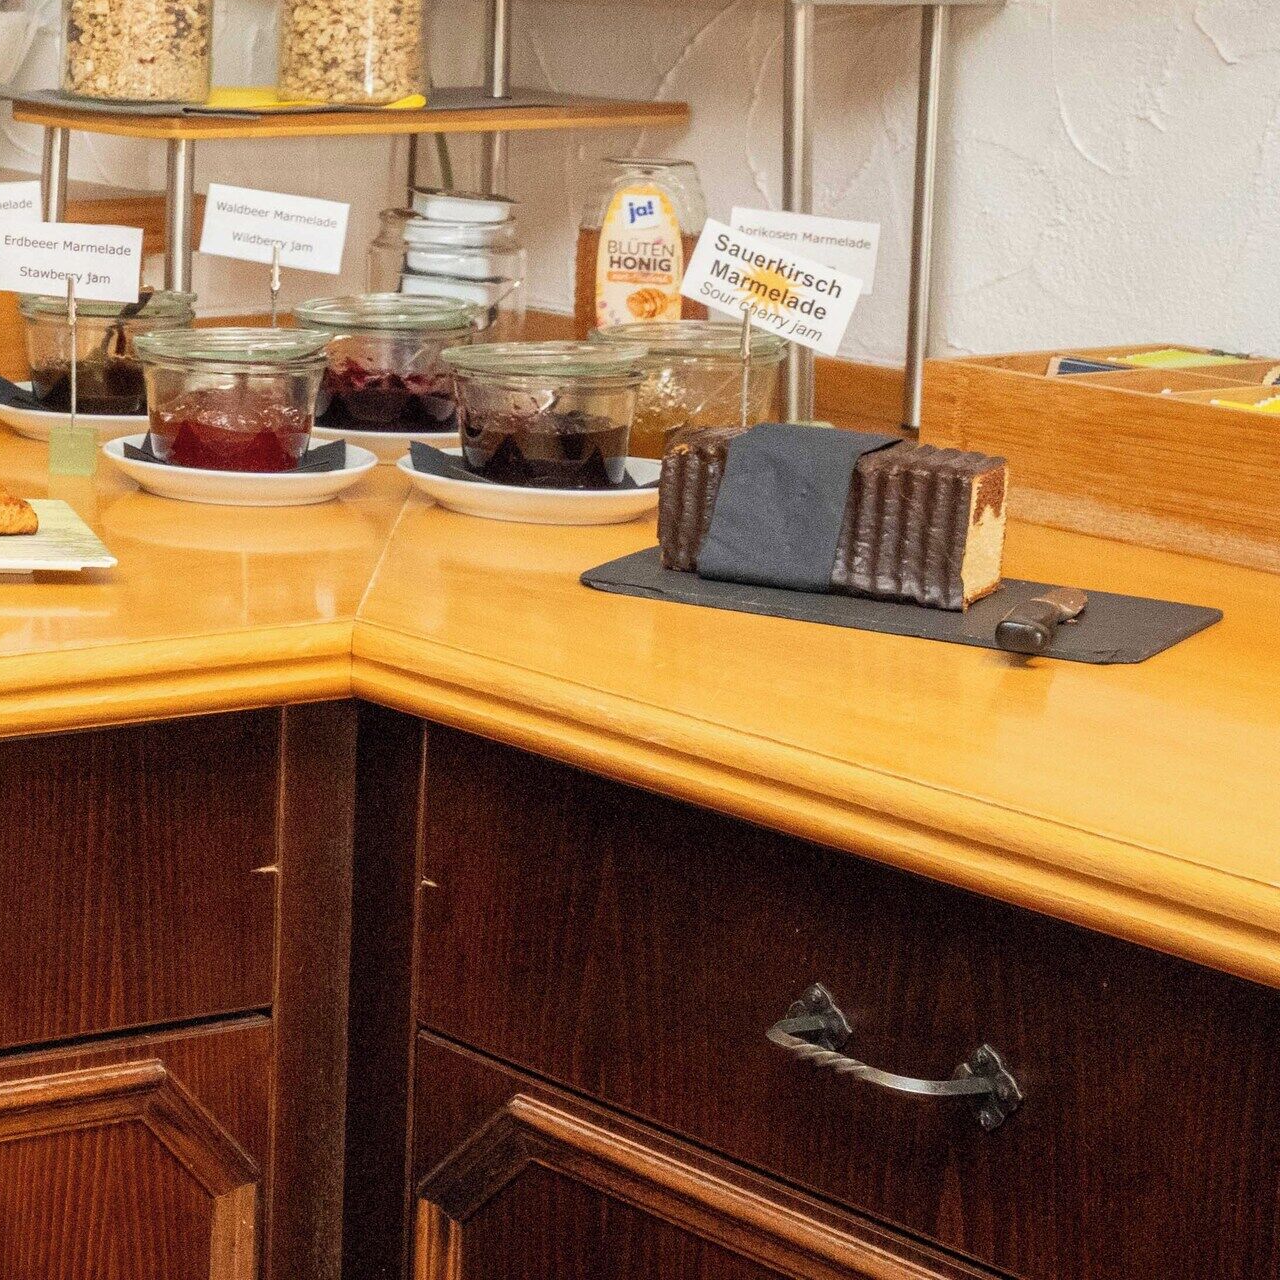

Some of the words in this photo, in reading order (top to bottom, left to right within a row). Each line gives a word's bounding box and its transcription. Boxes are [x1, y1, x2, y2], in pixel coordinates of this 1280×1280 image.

[216, 200, 270, 218] Waldbeer
[273, 209, 338, 229] Marmelade
[628, 200, 654, 224] ja!
[4, 235, 58, 251] Erdbeeer
[62, 237, 132, 257] Marmelade
[231, 231, 288, 250] Wildberry
[290, 240, 314, 253] jam
[607, 237, 676, 258] BLÜTEN
[802, 231, 872, 250] Marmelade
[609, 256, 673, 272] HONIG
[714, 233, 843, 299] Sauerkirsch
[19, 266, 83, 284] Stawberry
[86, 271, 111, 285] jam
[710, 258, 827, 320] Marmelade
[699, 280, 738, 306] Sour
[739, 298, 790, 330] cherry
[789, 320, 823, 342] jam
